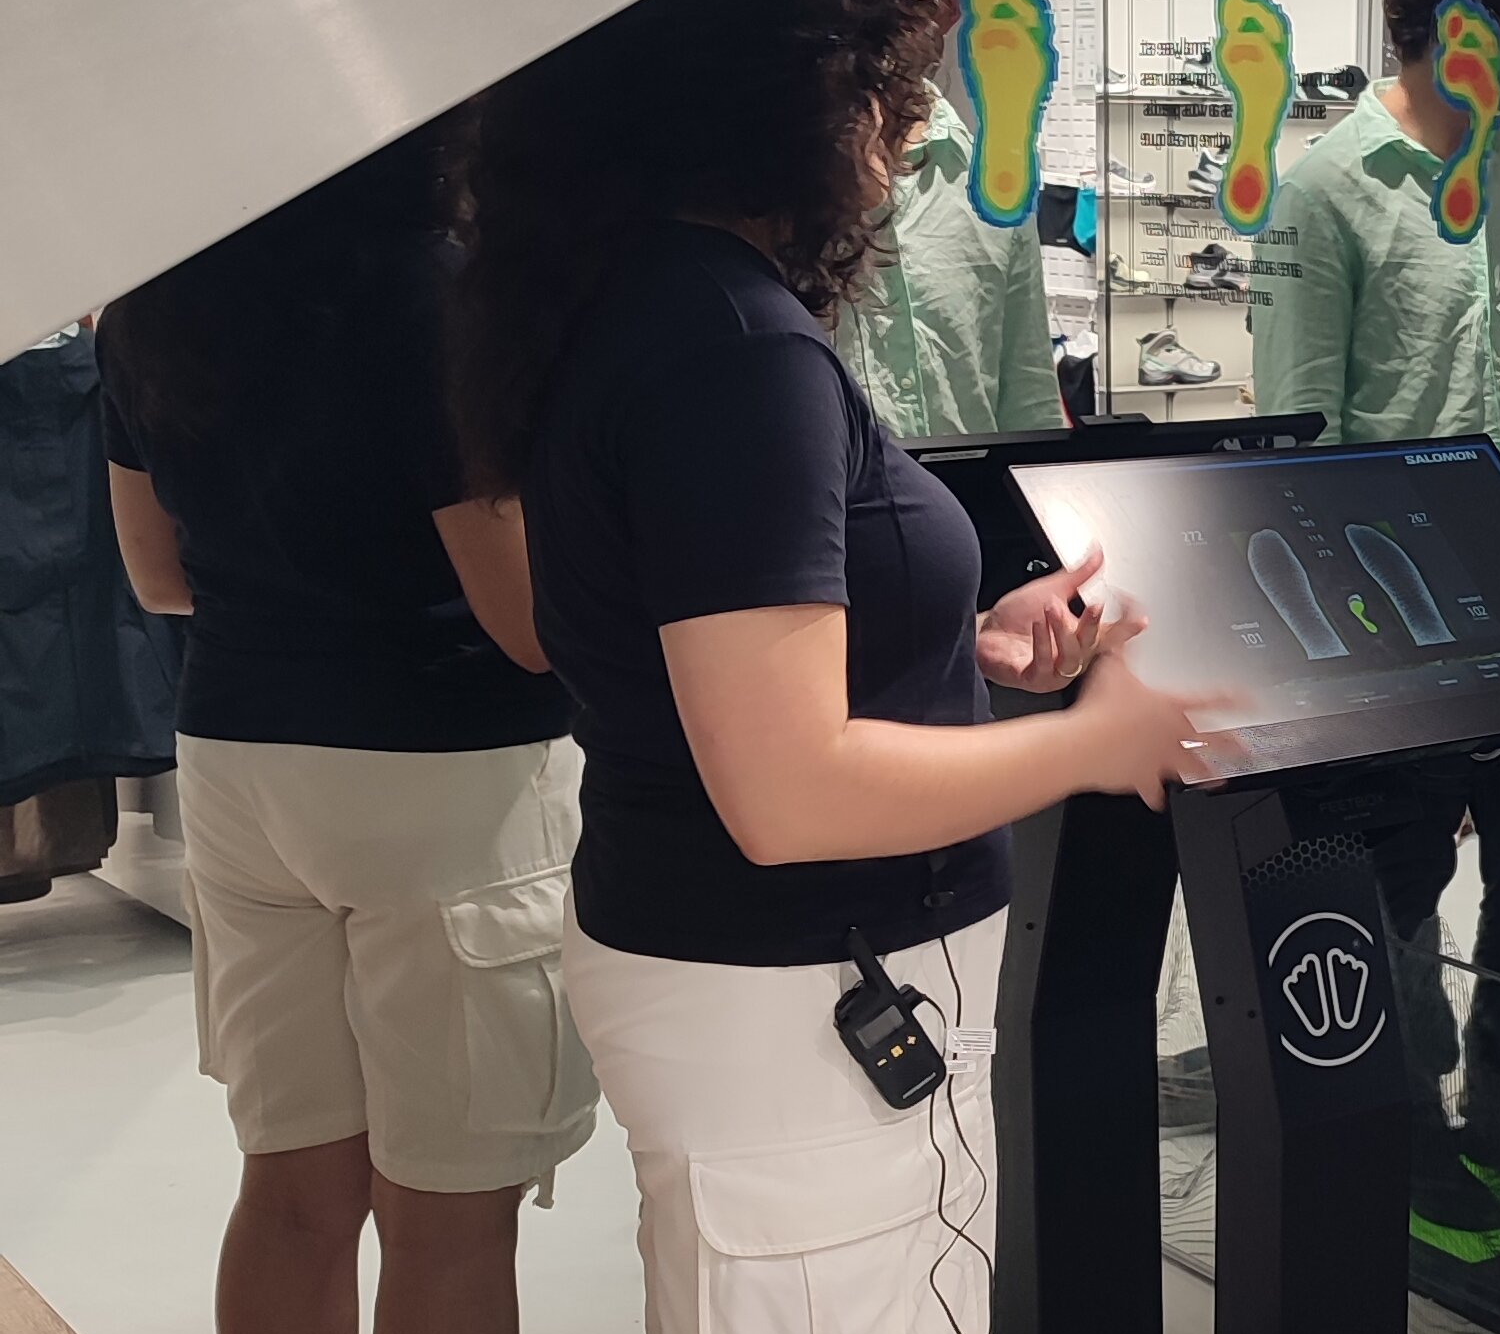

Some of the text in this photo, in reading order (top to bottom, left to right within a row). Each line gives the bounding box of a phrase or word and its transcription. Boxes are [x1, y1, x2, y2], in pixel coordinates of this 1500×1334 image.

[1403, 450, 1479, 466] SALOMON
[1408, 512, 1428, 525] 267
[1181, 530, 1205, 543] 272
[1466, 604, 1489, 617] 102
[1240, 632, 1264, 645] 101
